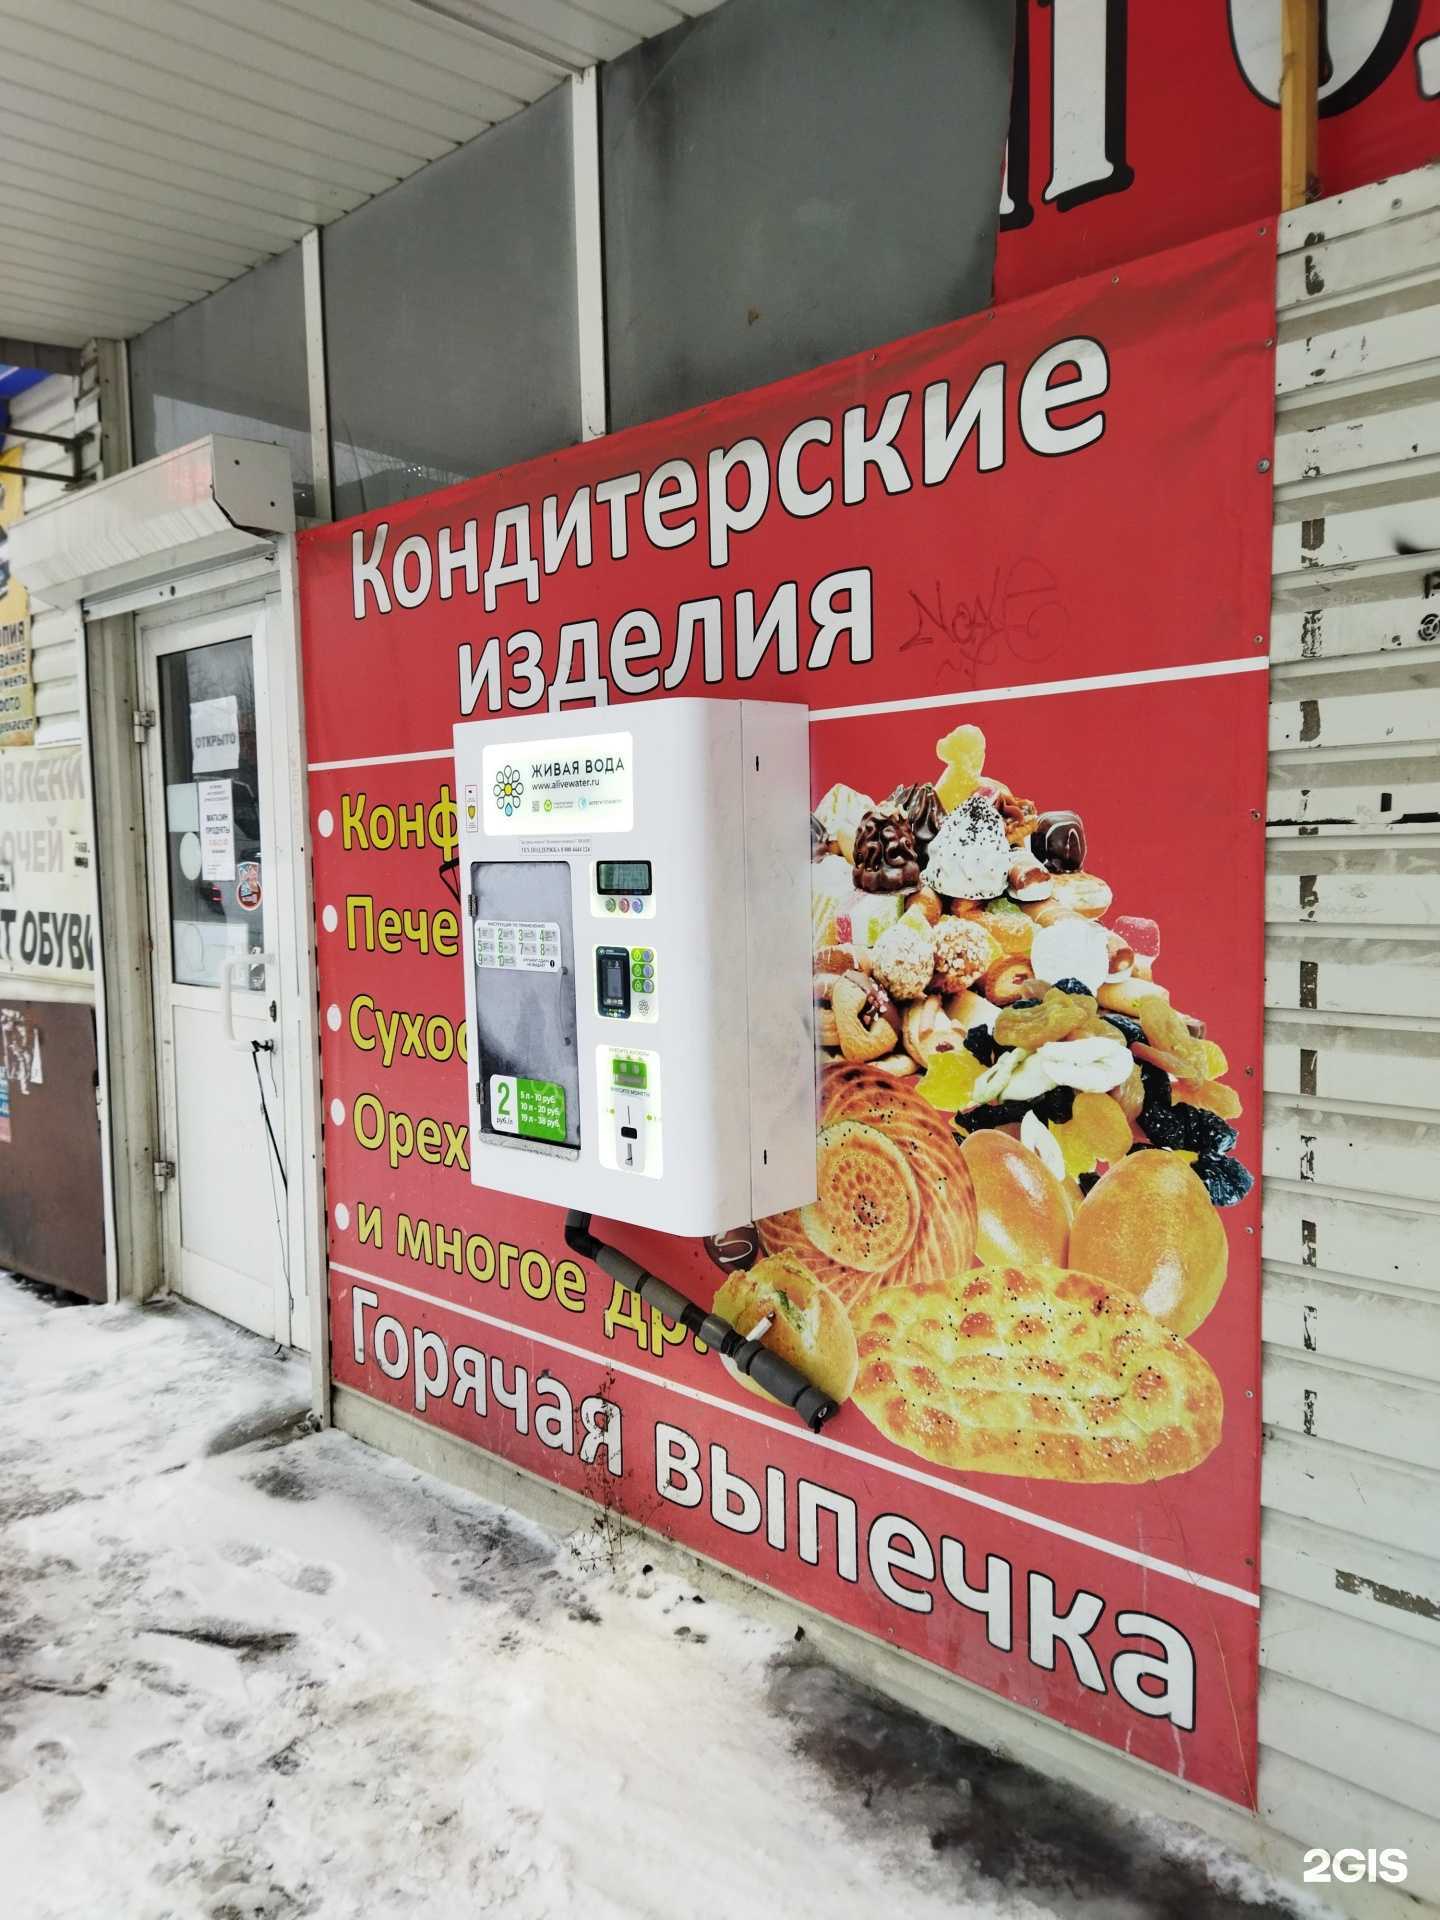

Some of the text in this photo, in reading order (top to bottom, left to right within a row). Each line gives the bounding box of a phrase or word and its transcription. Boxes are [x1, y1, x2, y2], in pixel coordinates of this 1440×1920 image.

[350, 335, 1110, 620] Кондитерские
[458, 567, 873, 715] изделия
[195, 732, 236, 749] ОТКРЫТО
[531, 757, 625, 778] ЖИВАЯ ВОДА
[531, 778, 600, 791] www.alivewater.ru
[346, 895, 458, 957] Пече
[498, 928, 503, 940] 2
[519, 929, 524, 941] 3
[540, 930, 544, 942] 4
[478, 940, 483, 952] 5
[518, 942, 524, 955] 7
[541, 943, 545, 956] 8
[498, 1082, 510, 1115] 2
[535, 1092, 542, 1102] 10
[521, 1102, 528, 1110] 10
[352, 1093, 470, 1171] Орех
[357, 1202, 383, 1249] и
[396, 1214, 587, 1313] многое
[351, 1285, 1197, 1731] Горячая выпечка
